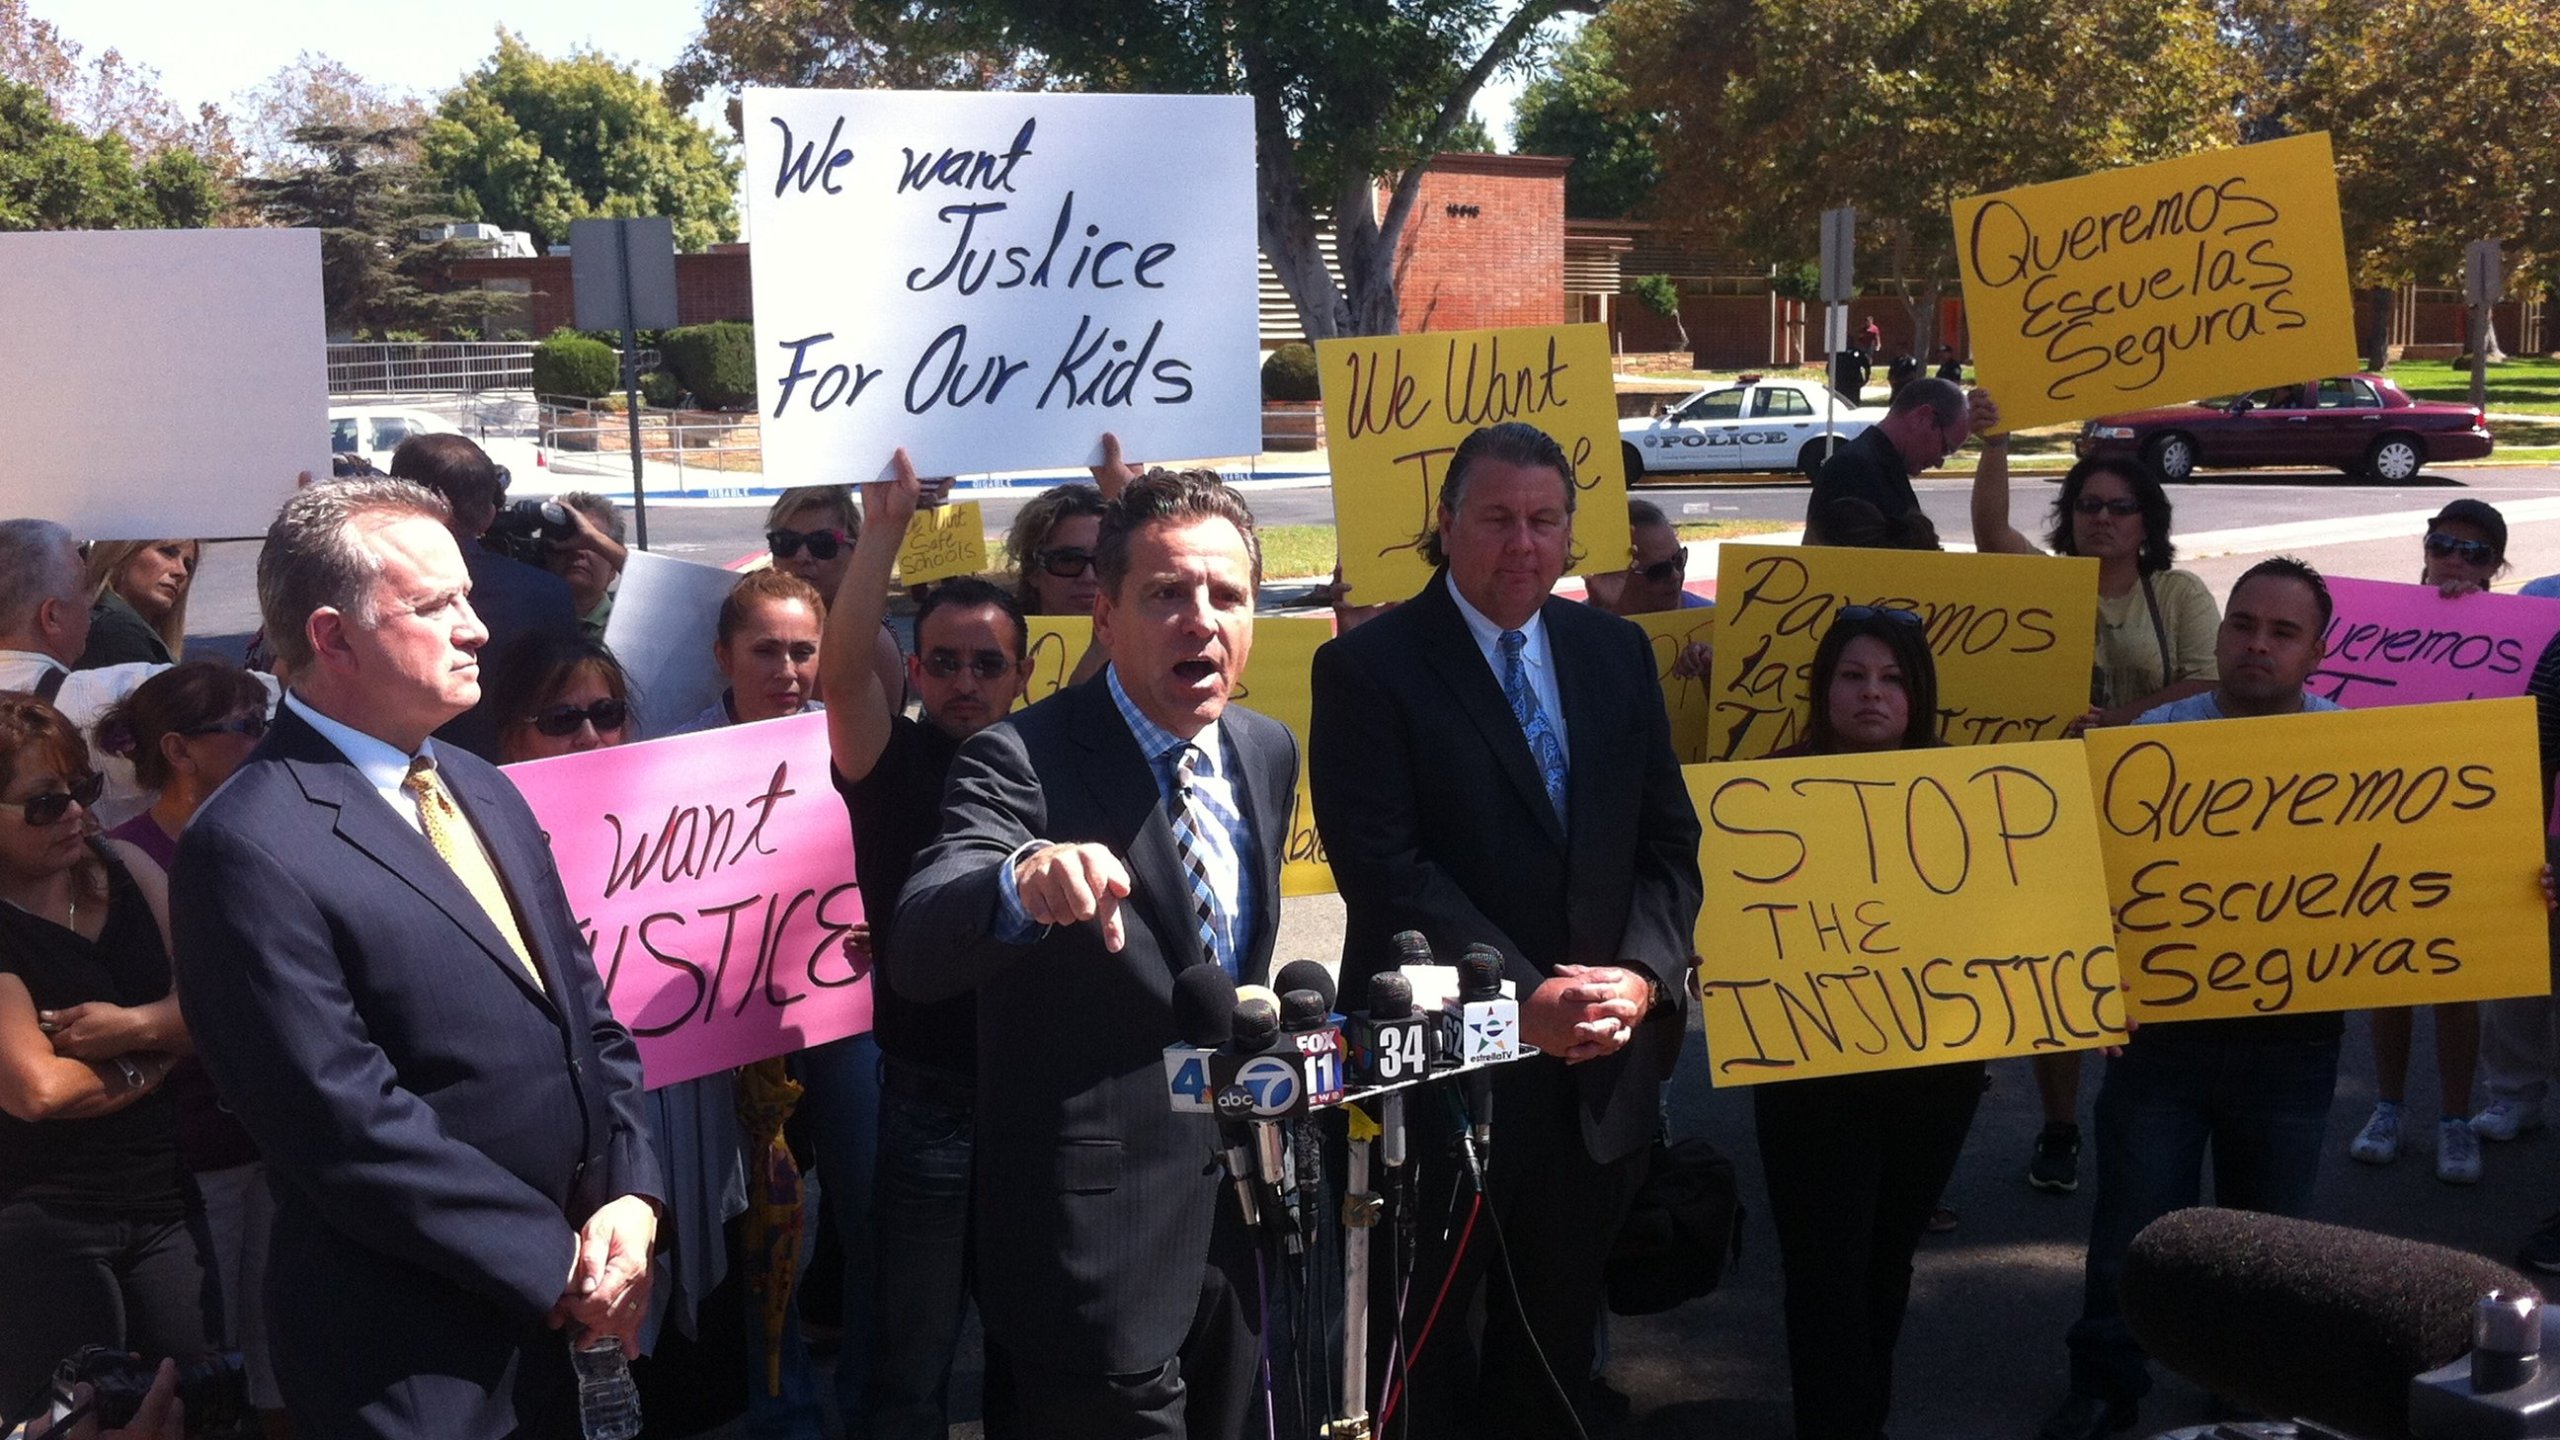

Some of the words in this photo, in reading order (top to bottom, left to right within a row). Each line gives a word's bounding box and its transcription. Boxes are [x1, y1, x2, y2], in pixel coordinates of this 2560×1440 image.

[771, 116, 854, 198] We
[897, 117, 1037, 194] want
[1971, 177, 2279, 287] Queremos
[2021, 240, 2293, 338] Escuelas
[773, 333, 883, 419] For
[905, 325, 1028, 415] Our
[1036, 315, 1194, 411] Kids
[2046, 289, 2306, 400] Seguras
[1346, 349, 1431, 440] We
[1445, 336, 1569, 424] Want
[1660, 430, 1789, 449] POLICE
[2324, 617, 2523, 674] ueremos
[1710, 765, 2058, 895] STOP
[2103, 741, 2496, 842] Queremos
[2117, 843, 2453, 932] Escuelas
[577, 883, 860, 1038] USTICE
[1742, 900, 1901, 959] THE
[1702, 945, 2127, 1075] INJUSTICE
[2139, 937, 2462, 1012] Seguras
[1296, 1031, 1337, 1053] FOX
[1304, 1053, 1335, 1095] 11
[1379, 1025, 1426, 1078] 34
[1442, 1014, 1464, 1060] 62
[1171, 1058, 1206, 1104] 4
[1217, 1091, 1254, 1107] abc
[1241, 1066, 1294, 1111] 7
